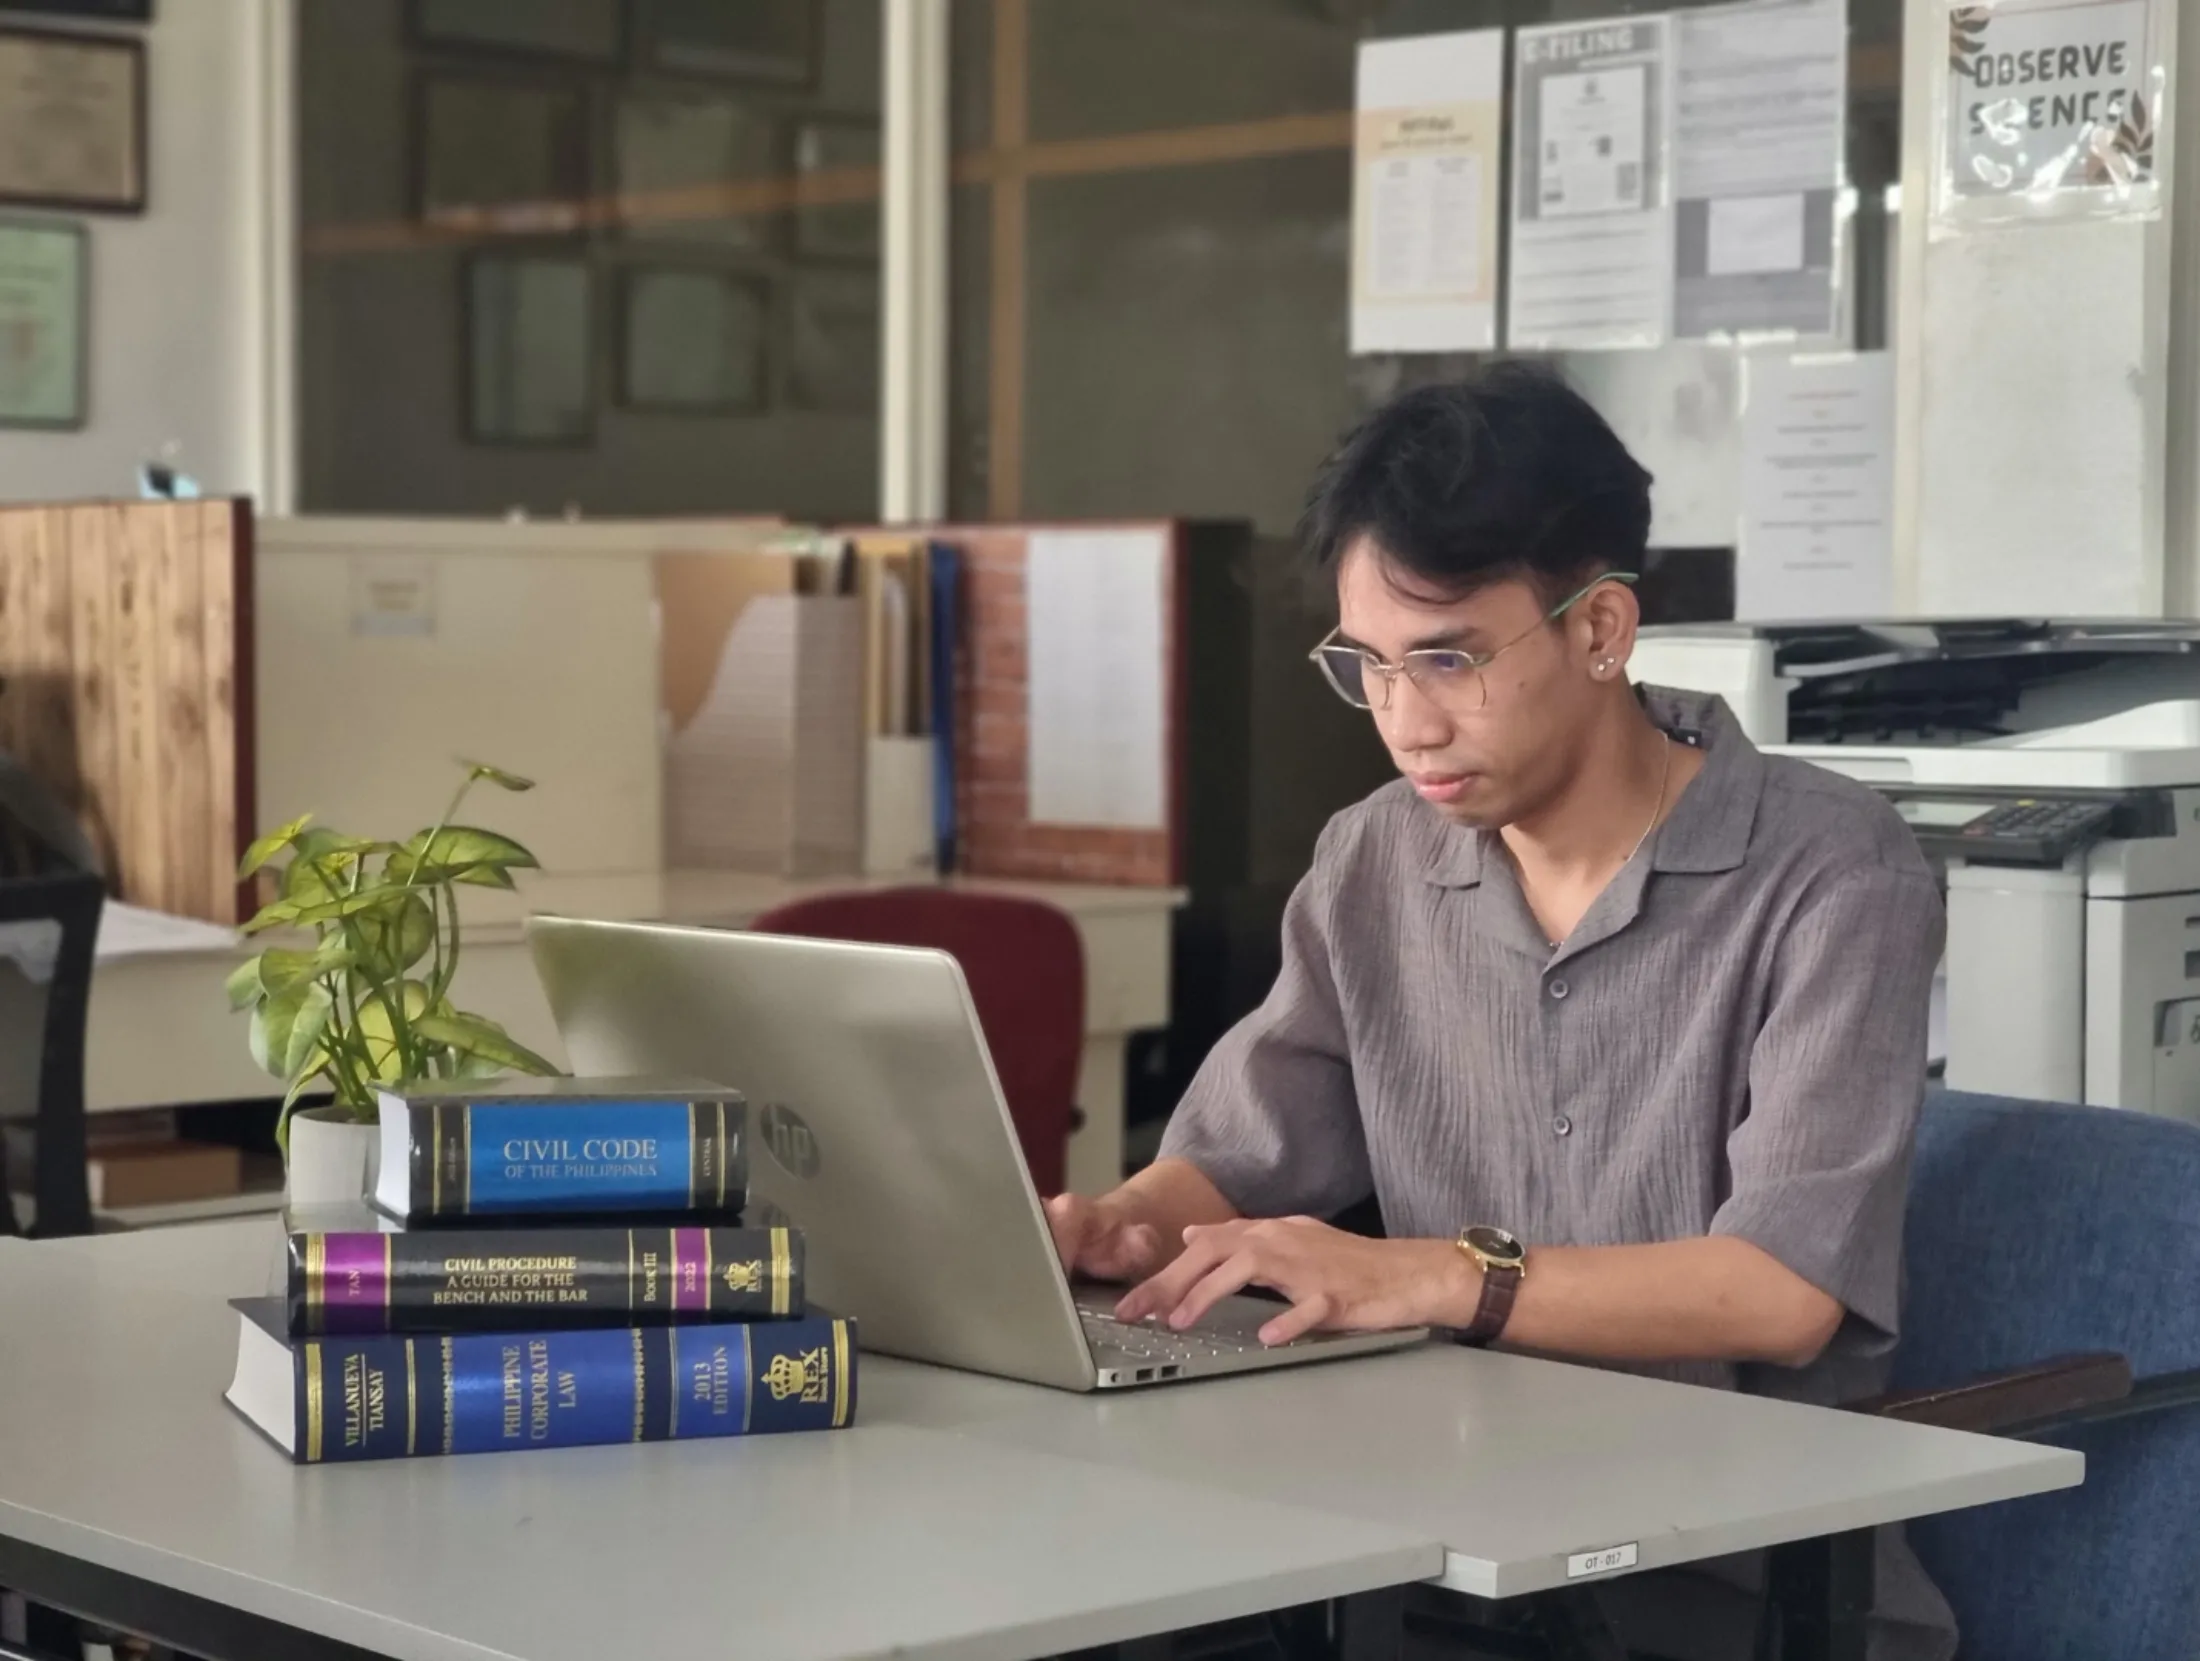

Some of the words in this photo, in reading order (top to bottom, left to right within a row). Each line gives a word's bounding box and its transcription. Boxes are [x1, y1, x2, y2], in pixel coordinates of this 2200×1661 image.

[1974, 41, 2127, 88] OBSERVE
[1968, 89, 2126, 134] SENCE
[504, 1139, 577, 1161] CIVIL
[583, 1139, 658, 1160] CODE
[505, 1165, 525, 1178] OF
[528, 1165, 559, 1178] THE
[565, 1164, 657, 1177] PHILIPPINES
[444, 1258, 485, 1271] CIVIL
[488, 1256, 577, 1270] PROCEDURE
[643, 1252, 657, 1267] III
[348, 1270, 360, 1297] TAN
[433, 1291, 485, 1304] BENCH
[488, 1290, 522, 1303] AND
[525, 1290, 554, 1302] THE
[559, 1289, 588, 1302] BAR
[447, 1275, 458, 1288] A
[461, 1275, 509, 1287] GUIDE
[512, 1274, 541, 1287] FOR
[544, 1273, 574, 1286] THE
[503, 1346, 521, 1438] PHILIPPINE
[529, 1340, 549, 1440] CORPORATE
[557, 1371, 576, 1408] LAW
[693, 1362, 711, 1401] 2013
[713, 1346, 728, 1415] EDITION
[799, 1347, 819, 1404] REX
[344, 1353, 360, 1447] VILLANUEVA
[368, 1368, 384, 1432] TIANSAY
